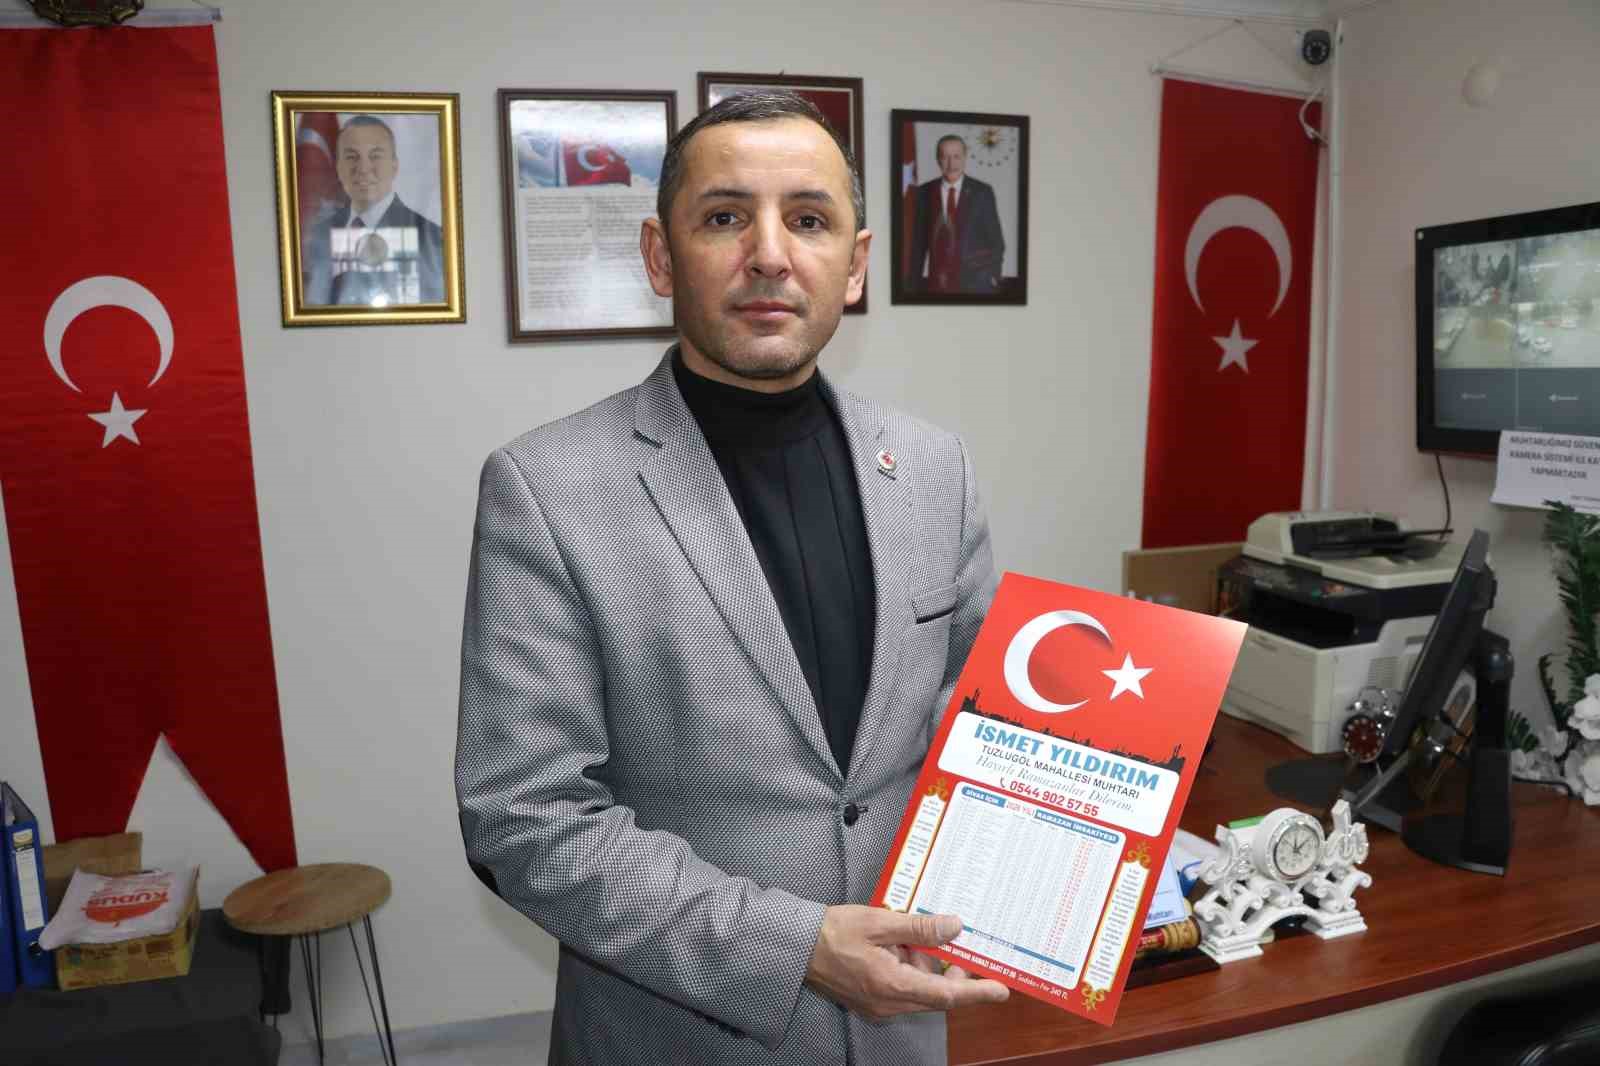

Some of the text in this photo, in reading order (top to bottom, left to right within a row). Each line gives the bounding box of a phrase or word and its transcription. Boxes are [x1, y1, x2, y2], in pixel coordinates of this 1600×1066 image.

[1509, 450, 1541, 460] KAMERA
[973, 718, 1159, 791] İSMET YILDIRIM
[1016, 767, 1085, 797] Ramazanlar
[1033, 760, 1091, 784] MAHALLESİ
[1092, 779, 1140, 799] MUHTARI
[1008, 780, 1099, 816] 0544 902 57 55
